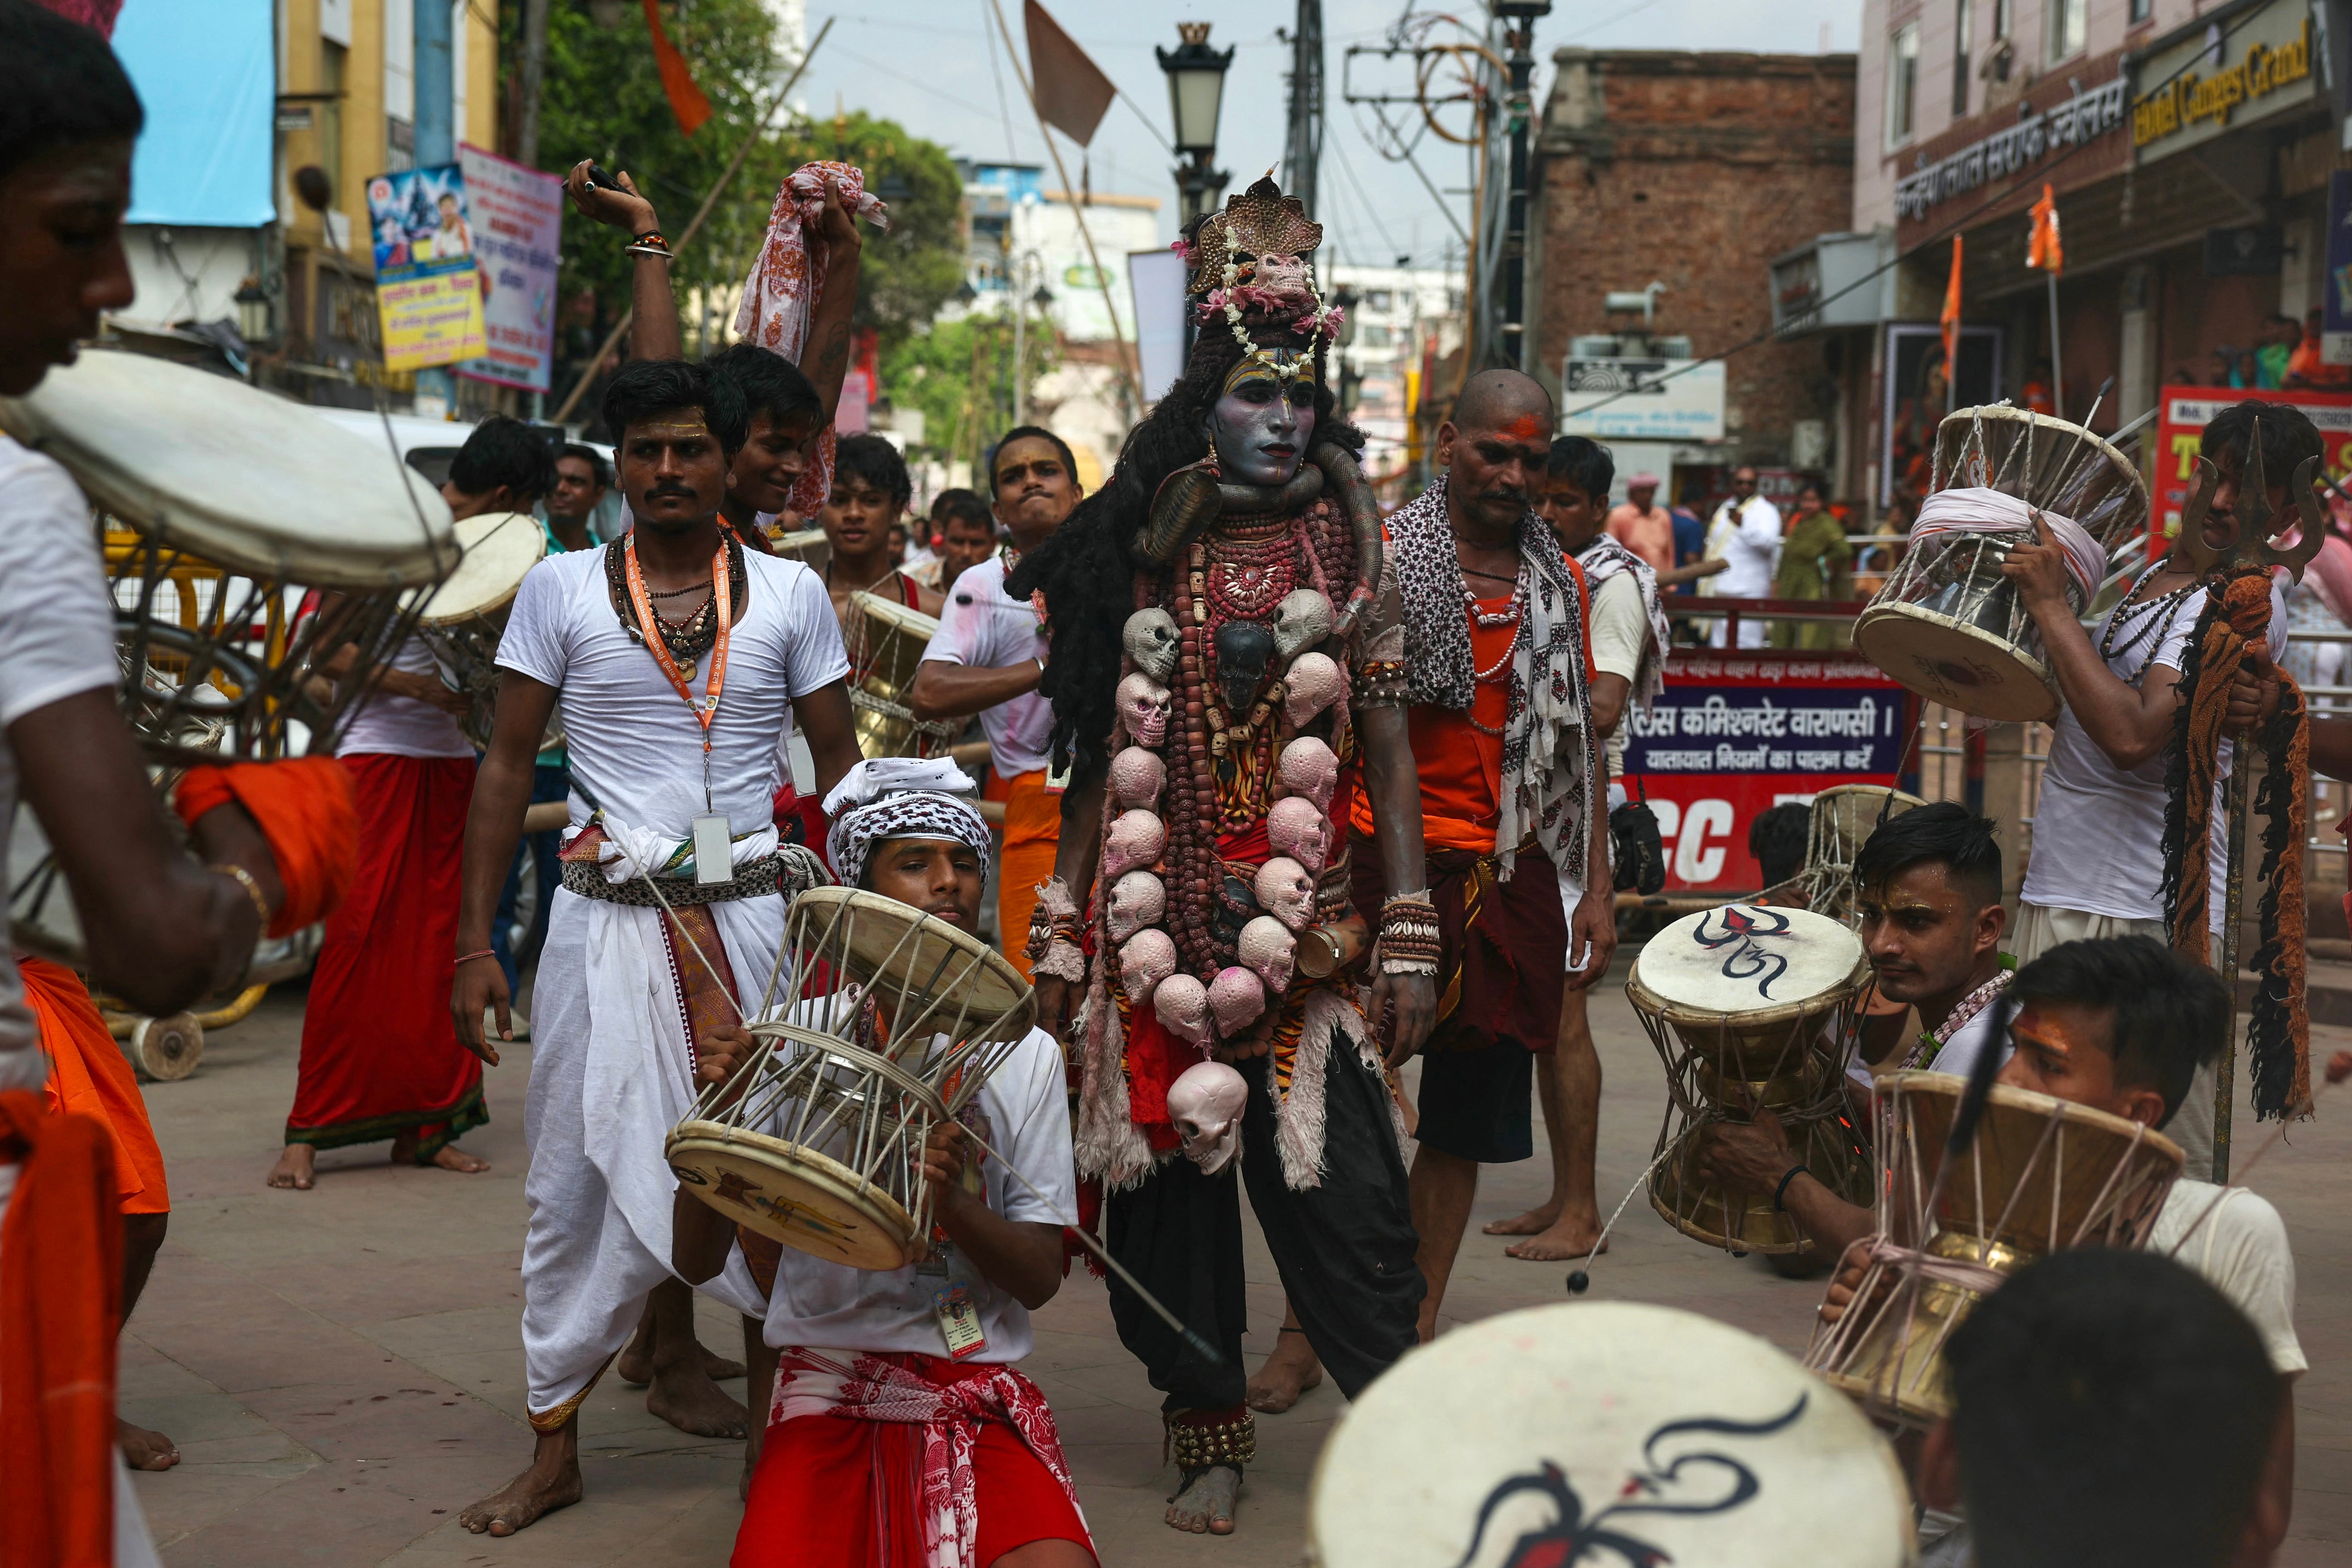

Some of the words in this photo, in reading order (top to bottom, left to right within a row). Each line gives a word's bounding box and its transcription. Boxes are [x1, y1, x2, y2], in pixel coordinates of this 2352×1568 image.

[2133, 78, 2179, 147] Hotel
[2179, 72, 2242, 126] Ganges
[2245, 19, 2310, 99] Grand
[628, 555, 633, 565] दल
[715, 552, 724, 568] काशी
[716, 569, 725, 596] विश्वनाथ
[636, 595, 650, 631] महाश्मशान
[648, 630, 665, 660] विश्वनाथ
[663, 660, 677, 678] काशी
[712, 672, 719, 684] दल
[1723, 658, 1757, 680] वाहन
[1681, 694, 1787, 737] कमिश्नरेट
[1790, 696, 1877, 737] वाराणसी
[1645, 749, 1713, 770] यातायात
[1715, 742, 1770, 771] नियमों
[1768, 749, 1793, 770] का
[1795, 749, 1841, 771] पालन
[1843, 744, 1874, 770] करें
